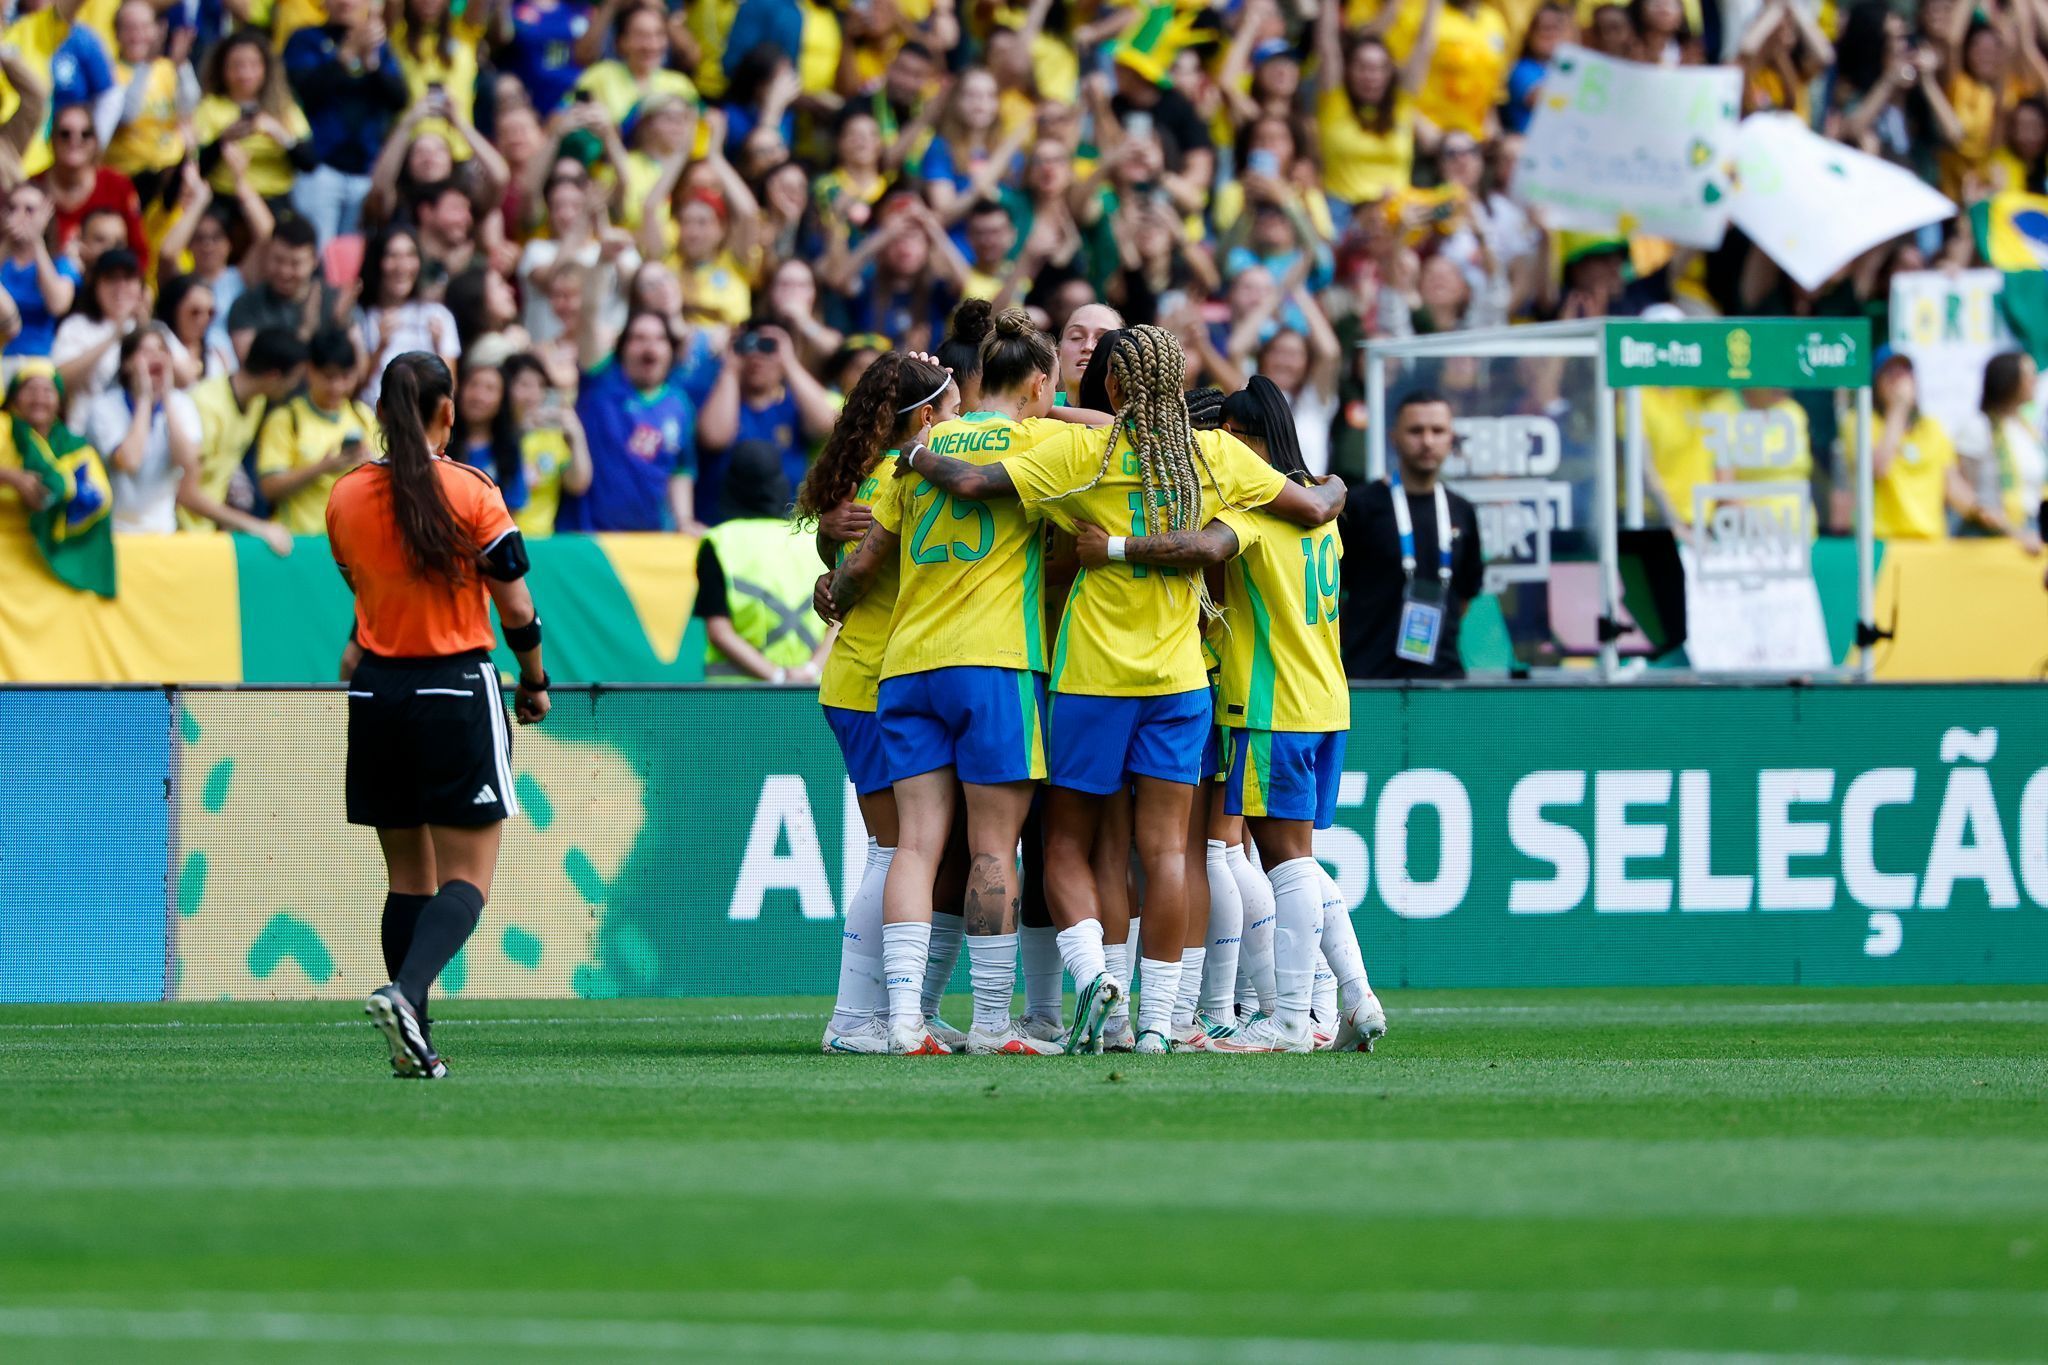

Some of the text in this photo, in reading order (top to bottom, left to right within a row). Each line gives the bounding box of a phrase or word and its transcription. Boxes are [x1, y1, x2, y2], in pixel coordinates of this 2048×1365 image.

[929, 427, 1011, 456] NIEHUES
[910, 479, 995, 565] 25
[1301, 534, 1339, 625] 19
